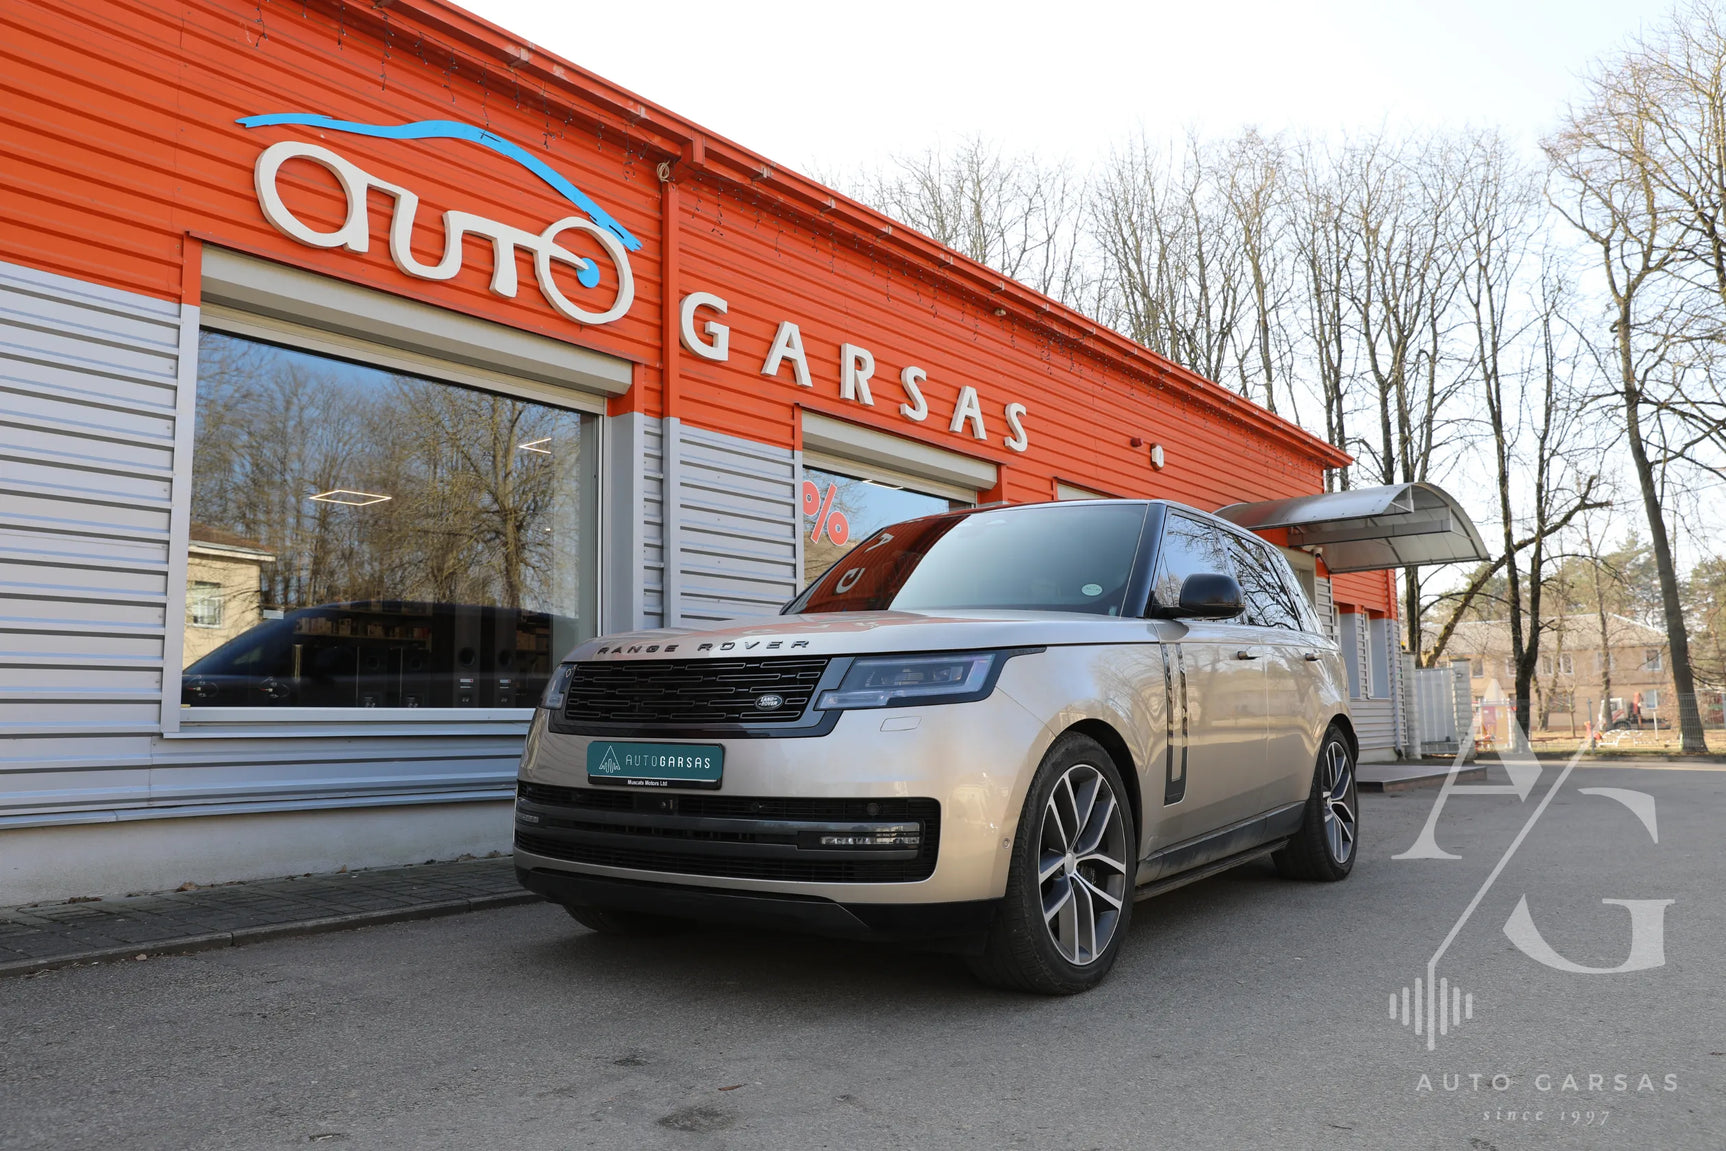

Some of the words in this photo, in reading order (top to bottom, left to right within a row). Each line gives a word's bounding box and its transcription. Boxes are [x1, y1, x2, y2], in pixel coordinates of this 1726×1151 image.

[679, 291, 1030, 454] GARSAS
[597, 644, 679, 656] RANGE
[697, 640, 810, 652] ROVER
